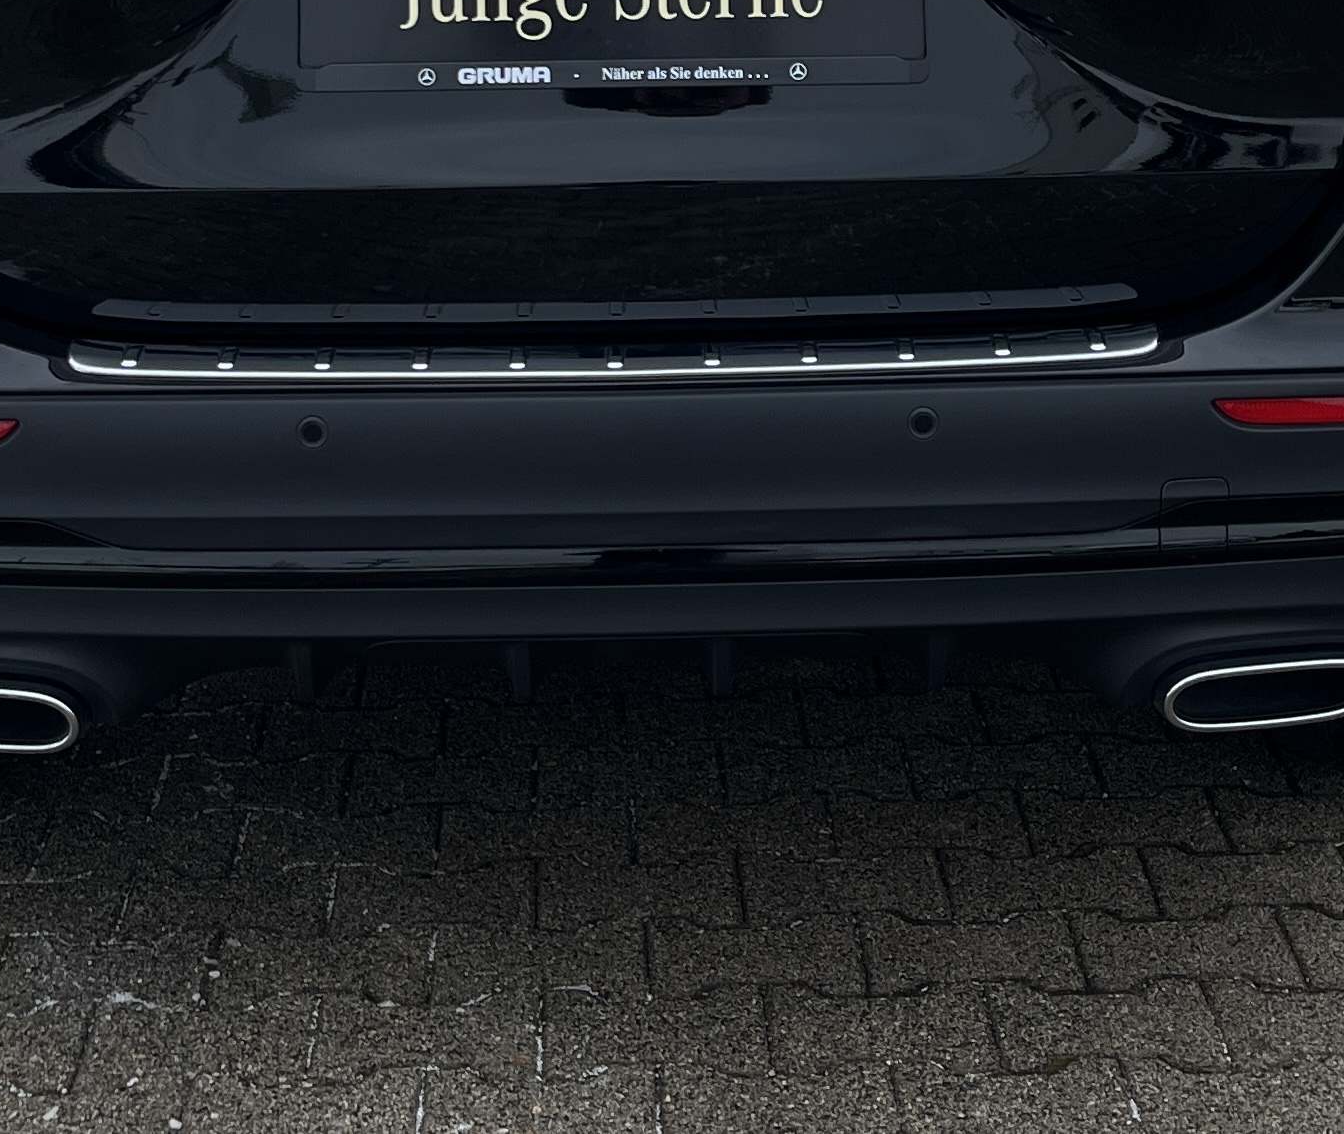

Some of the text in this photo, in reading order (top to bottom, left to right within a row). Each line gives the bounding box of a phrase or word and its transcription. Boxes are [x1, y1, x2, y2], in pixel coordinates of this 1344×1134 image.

[457, 66, 552, 85] GRUMA
[601, 66, 644, 81] Näher
[647, 66, 668, 80] als
[669, 66, 692, 80] Sie
